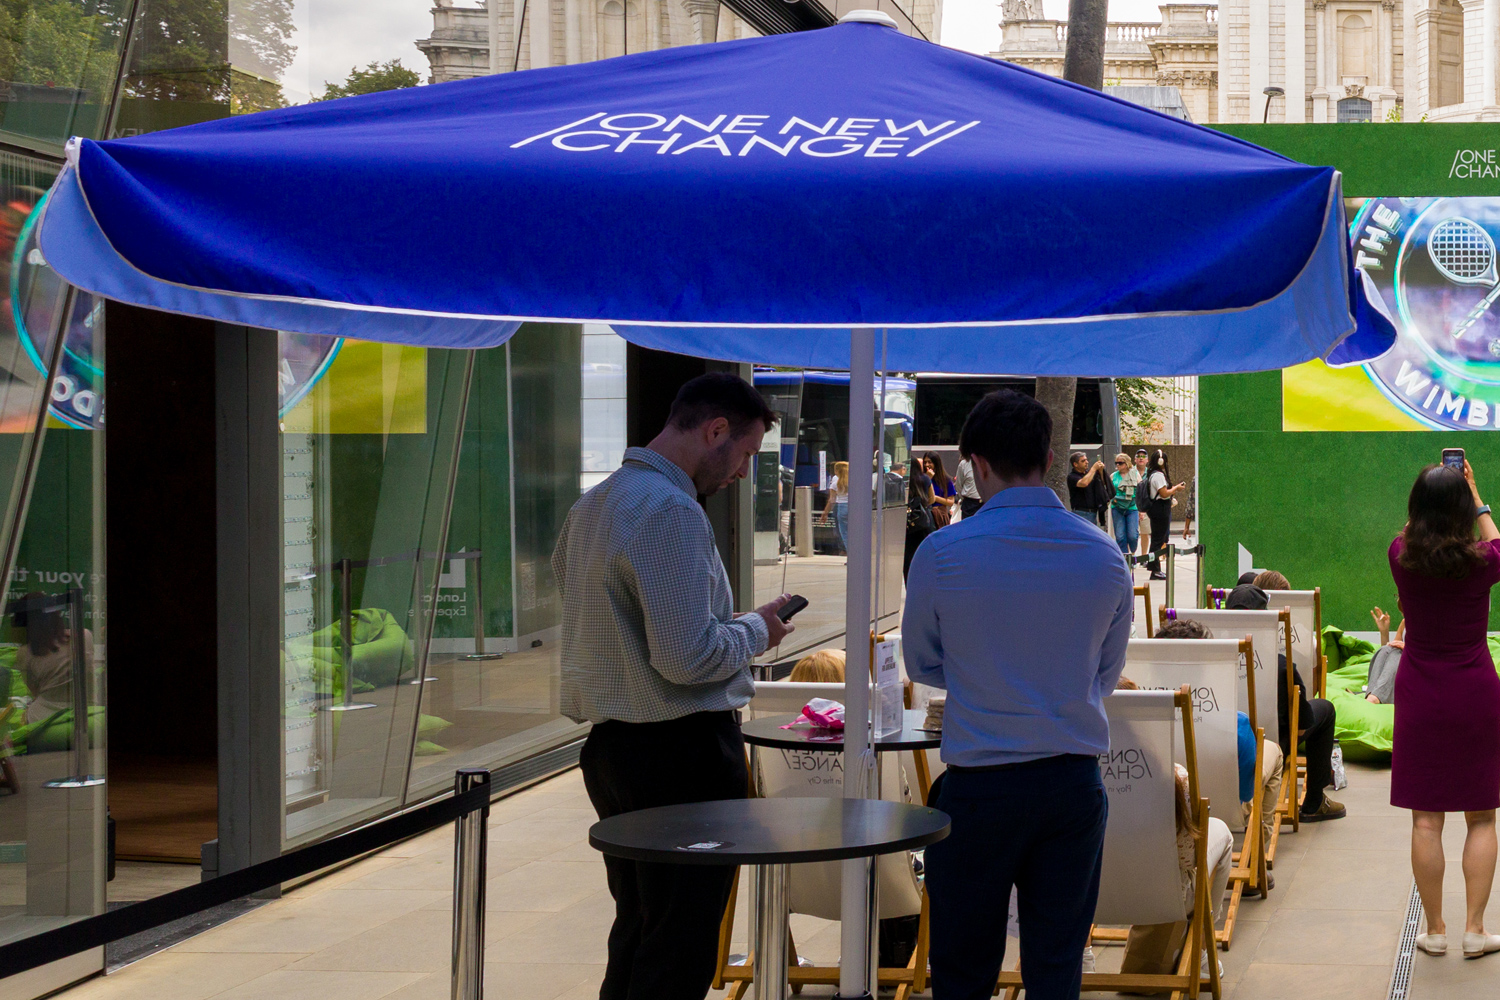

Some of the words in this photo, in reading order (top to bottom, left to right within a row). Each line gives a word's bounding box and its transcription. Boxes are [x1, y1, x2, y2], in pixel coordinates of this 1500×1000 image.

[600, 112, 771, 134] ONE
[778, 116, 957, 136] NEW
[551, 130, 910, 157] CHANGE
[1460, 149, 1496, 164] ONE
[1355, 203, 1402, 271] THE
